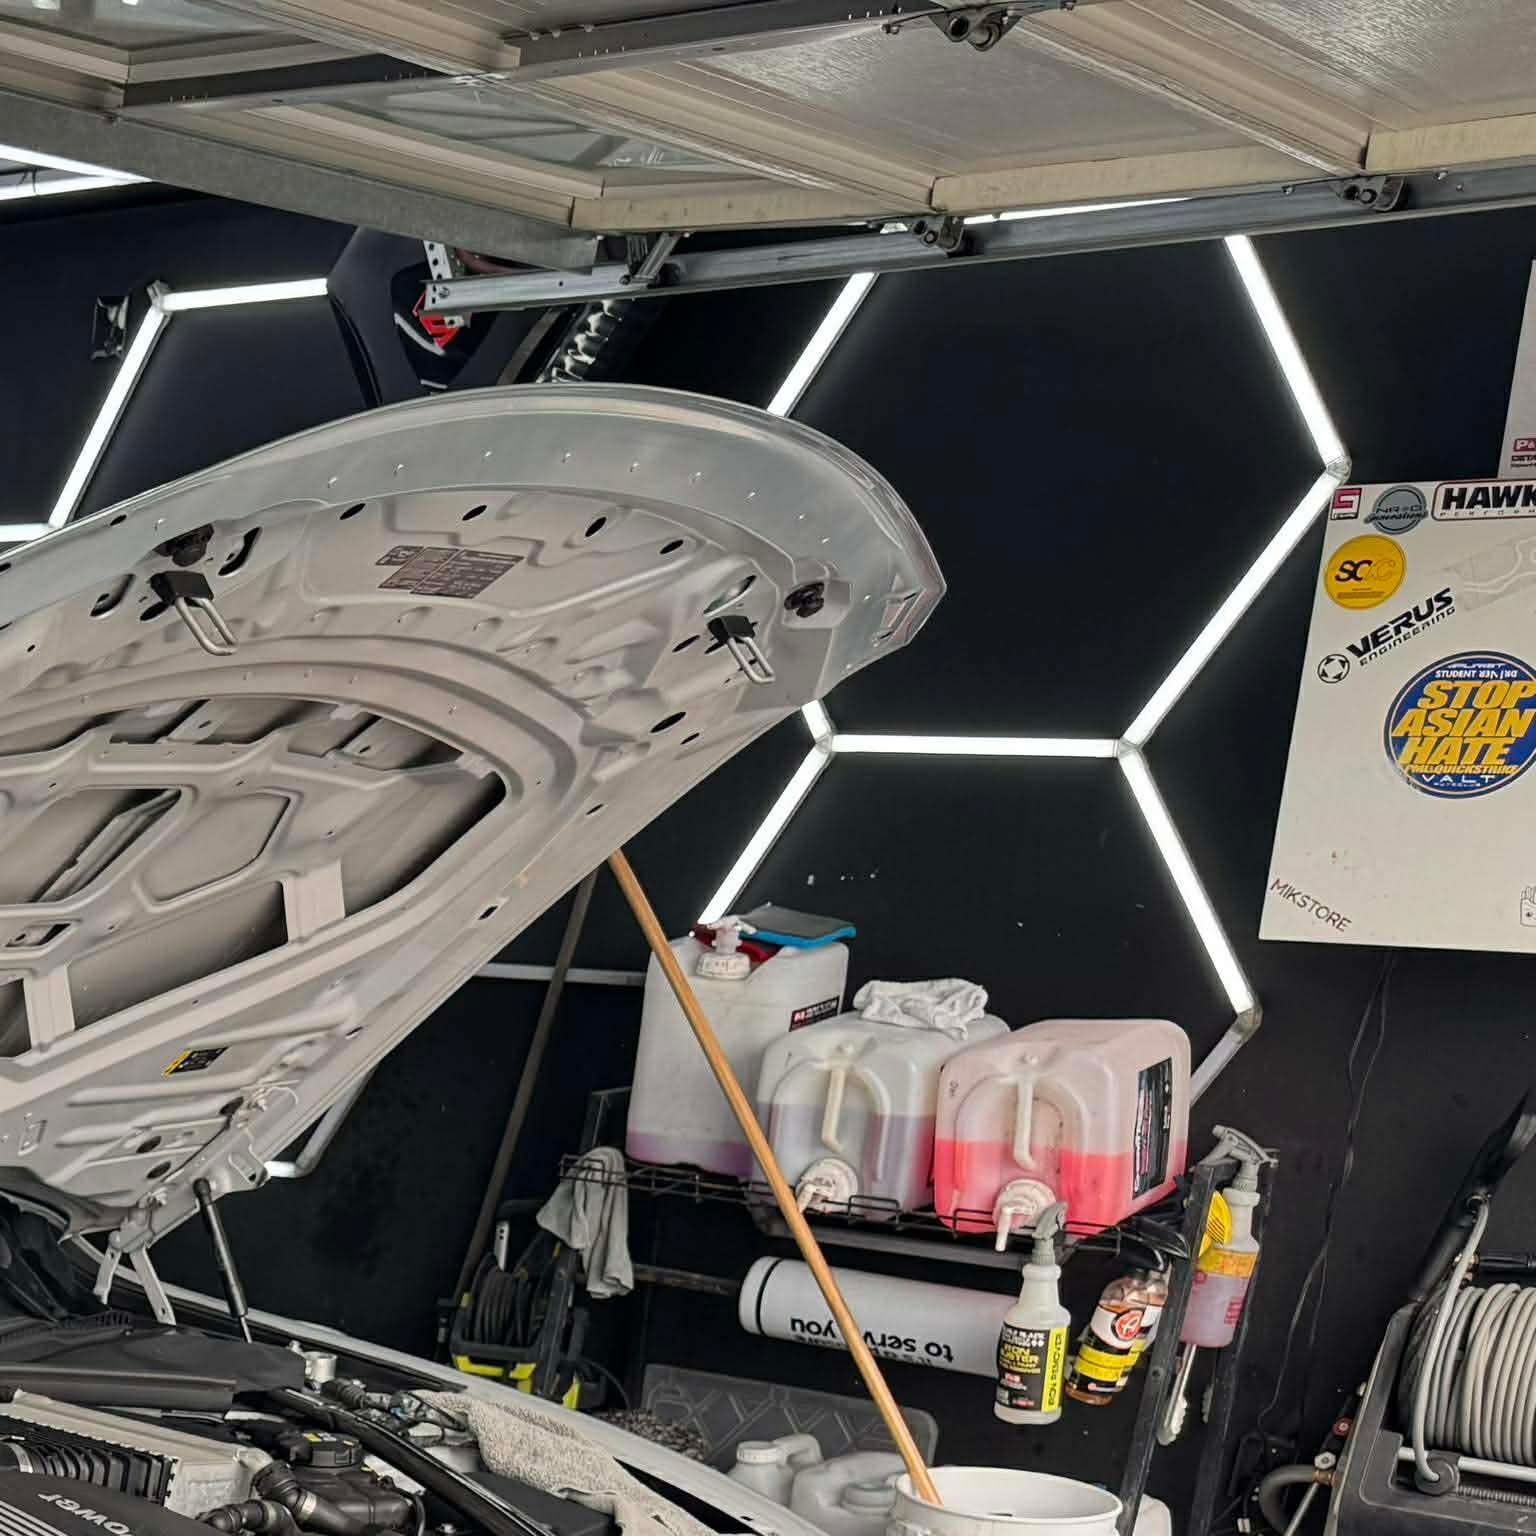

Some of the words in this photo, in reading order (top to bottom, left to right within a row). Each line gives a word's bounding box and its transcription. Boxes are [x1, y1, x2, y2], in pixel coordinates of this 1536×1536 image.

[1345, 587, 1454, 658] VERUS
[1417, 680, 1536, 709] STOP
[1391, 708, 1536, 738] ASIAN
[1399, 737, 1516, 766] HATE
[1422, 774, 1495, 783] VALT
[1270, 877, 1352, 932] MIKSTORE
[791, 1317, 837, 1339] you
[863, 1331, 917, 1354] serv
[924, 1342, 954, 1363] to
